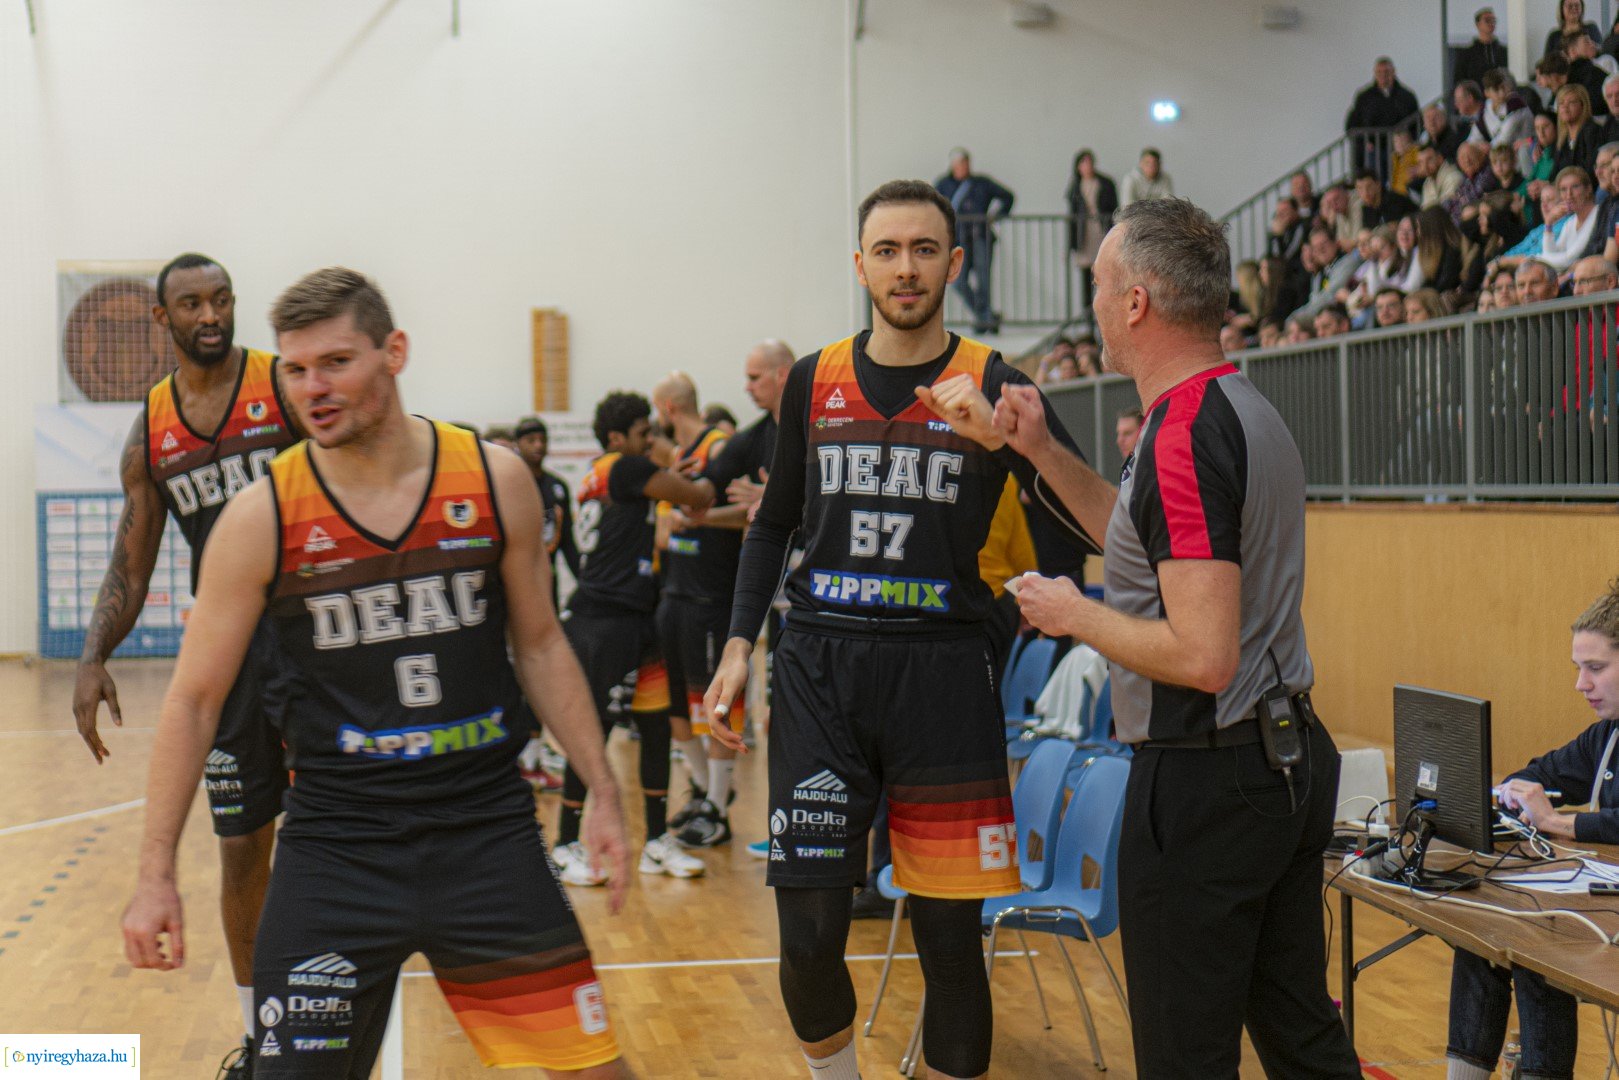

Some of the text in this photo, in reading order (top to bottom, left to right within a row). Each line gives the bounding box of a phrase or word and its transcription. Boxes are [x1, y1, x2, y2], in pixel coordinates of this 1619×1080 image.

[825, 400, 847, 410] PEAK
[928, 421, 955, 432] TiPP
[166, 447, 277, 516] DEAC
[817, 445, 964, 504] DEAC
[850, 510, 914, 560] 57
[304, 570, 489, 650] DEAC
[393, 653, 443, 708] 6
[792, 809, 847, 826] Delta
[793, 789, 848, 804] HAJDU-ALU
[287, 995, 352, 1013] Delta
[573, 981, 608, 1035] 6
